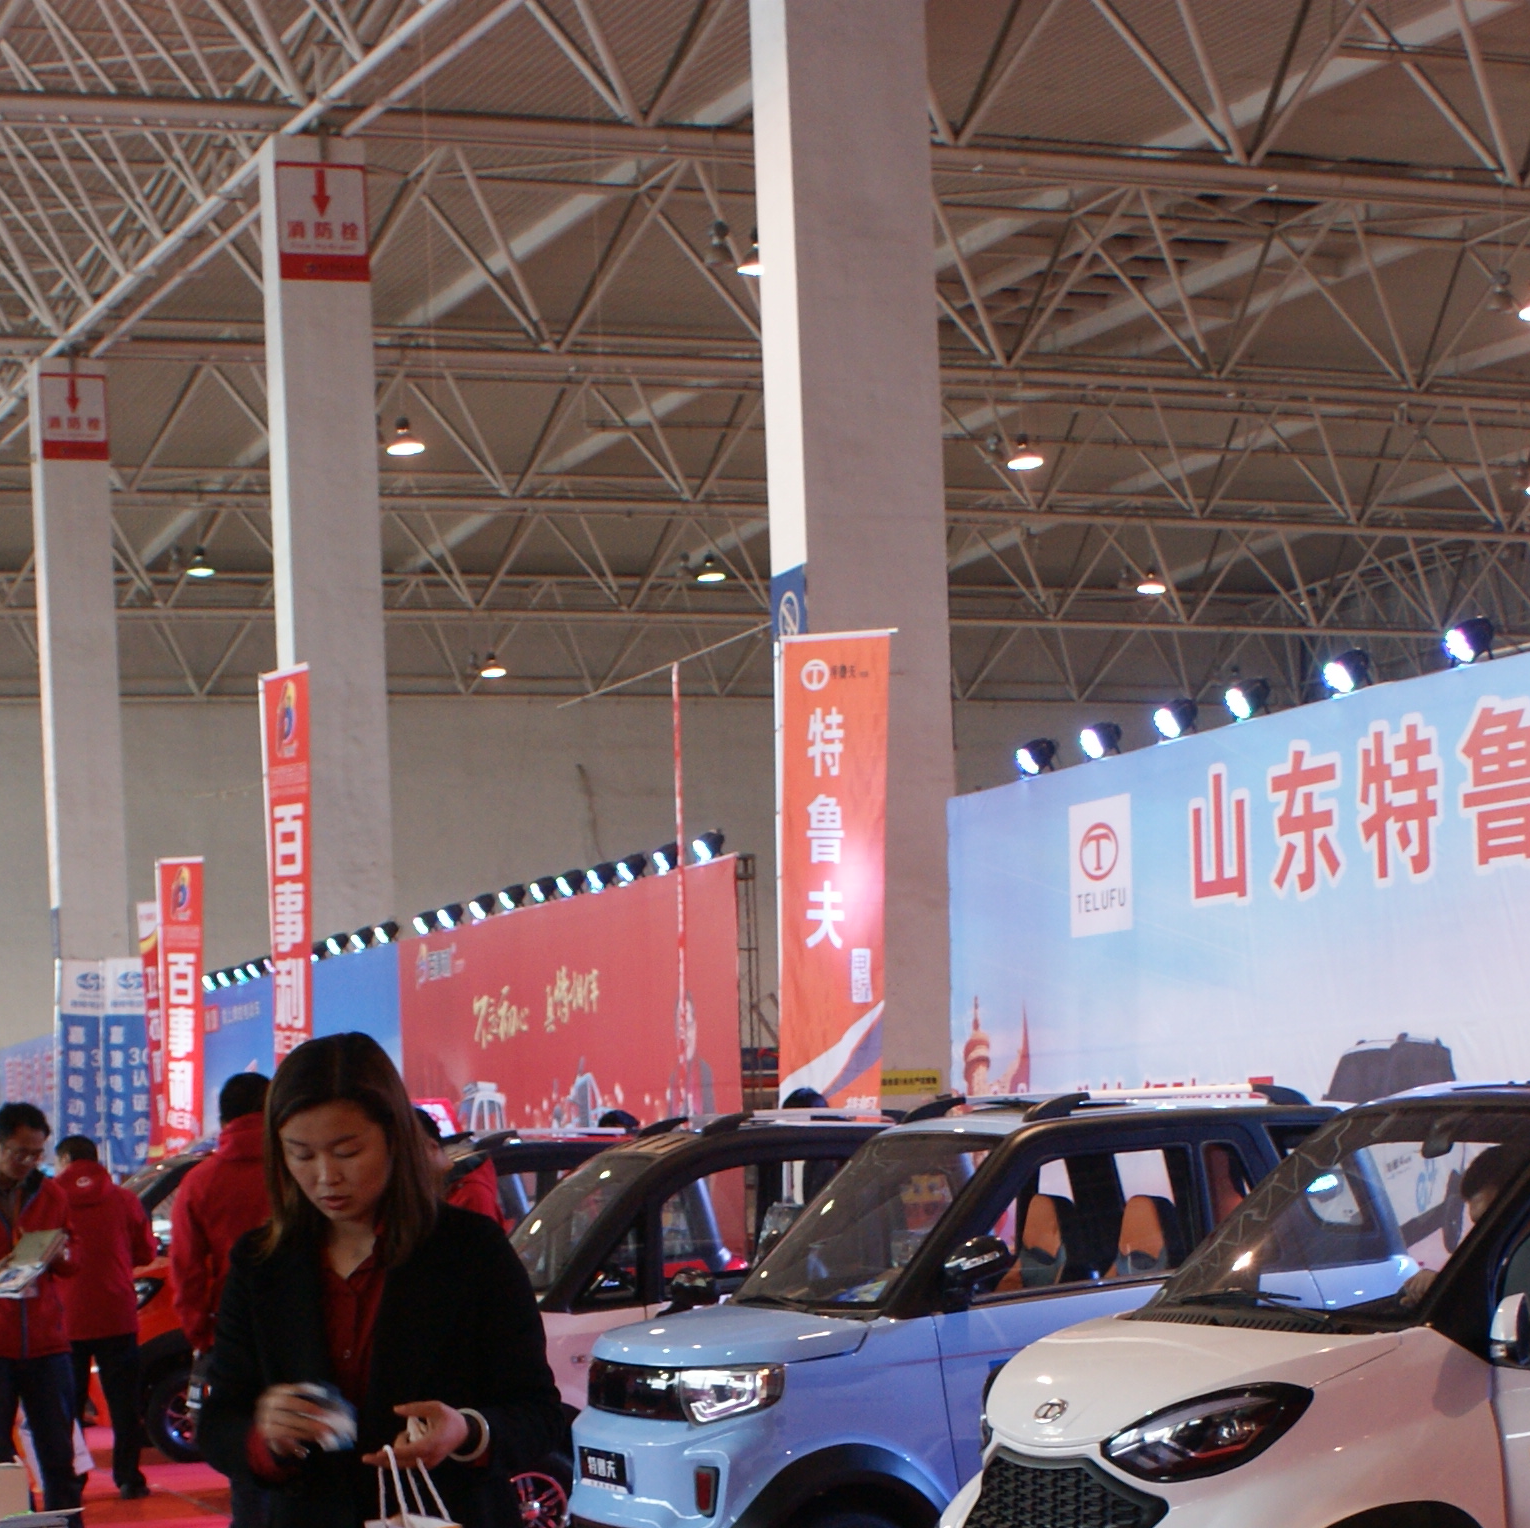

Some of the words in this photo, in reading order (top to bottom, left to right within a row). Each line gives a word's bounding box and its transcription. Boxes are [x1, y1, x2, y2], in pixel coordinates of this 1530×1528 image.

[273, 802, 306, 1030] 百事利
[806, 706, 846, 949] 特鲁夫
[1076, 886, 1127, 915] TELUFU
[166, 952, 197, 1112] 百事利
